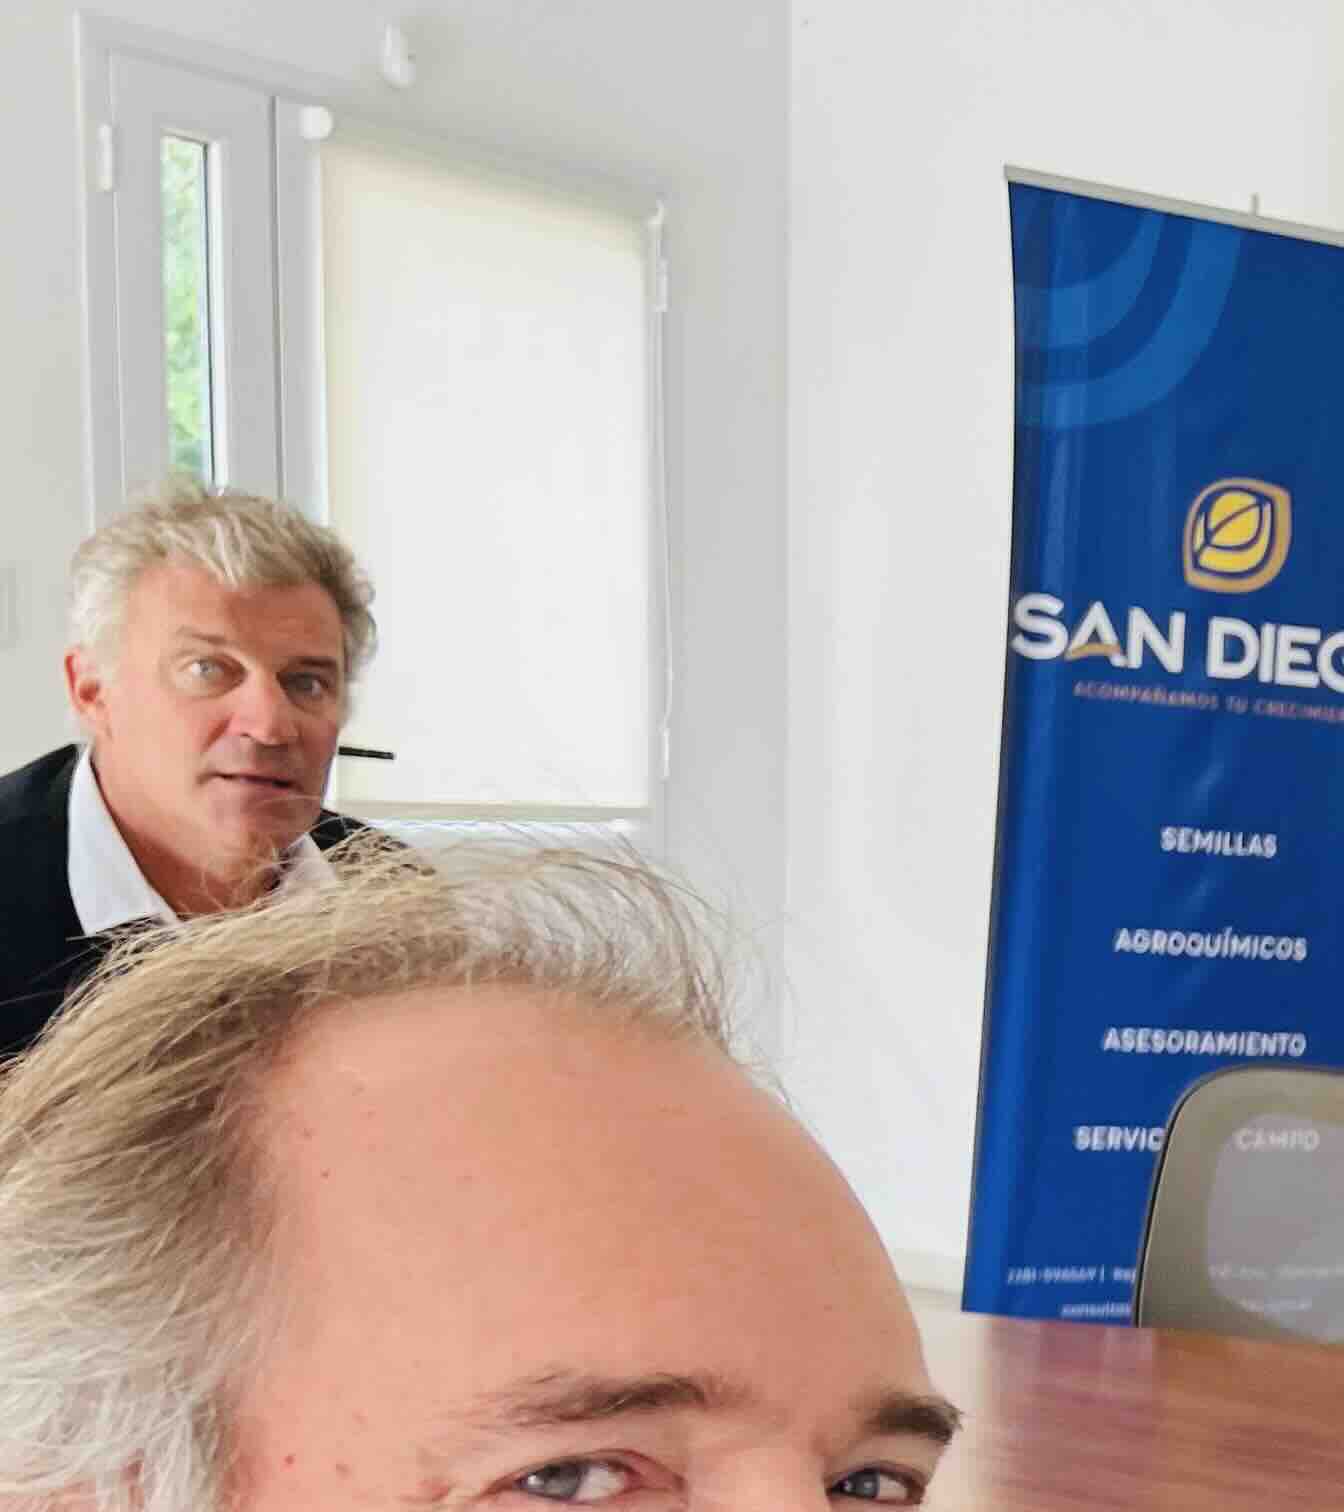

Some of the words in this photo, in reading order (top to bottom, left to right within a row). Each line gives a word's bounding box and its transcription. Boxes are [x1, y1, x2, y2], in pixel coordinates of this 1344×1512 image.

[1011, 592, 1187, 674] SAN
[1160, 827, 1277, 858] SEMILLAS
[1114, 926, 1307, 962] AGROQUÍMICOS
[1102, 1027, 1307, 1057] ASESORAMIENTO
[1075, 1126, 1167, 1151] SERVIC
